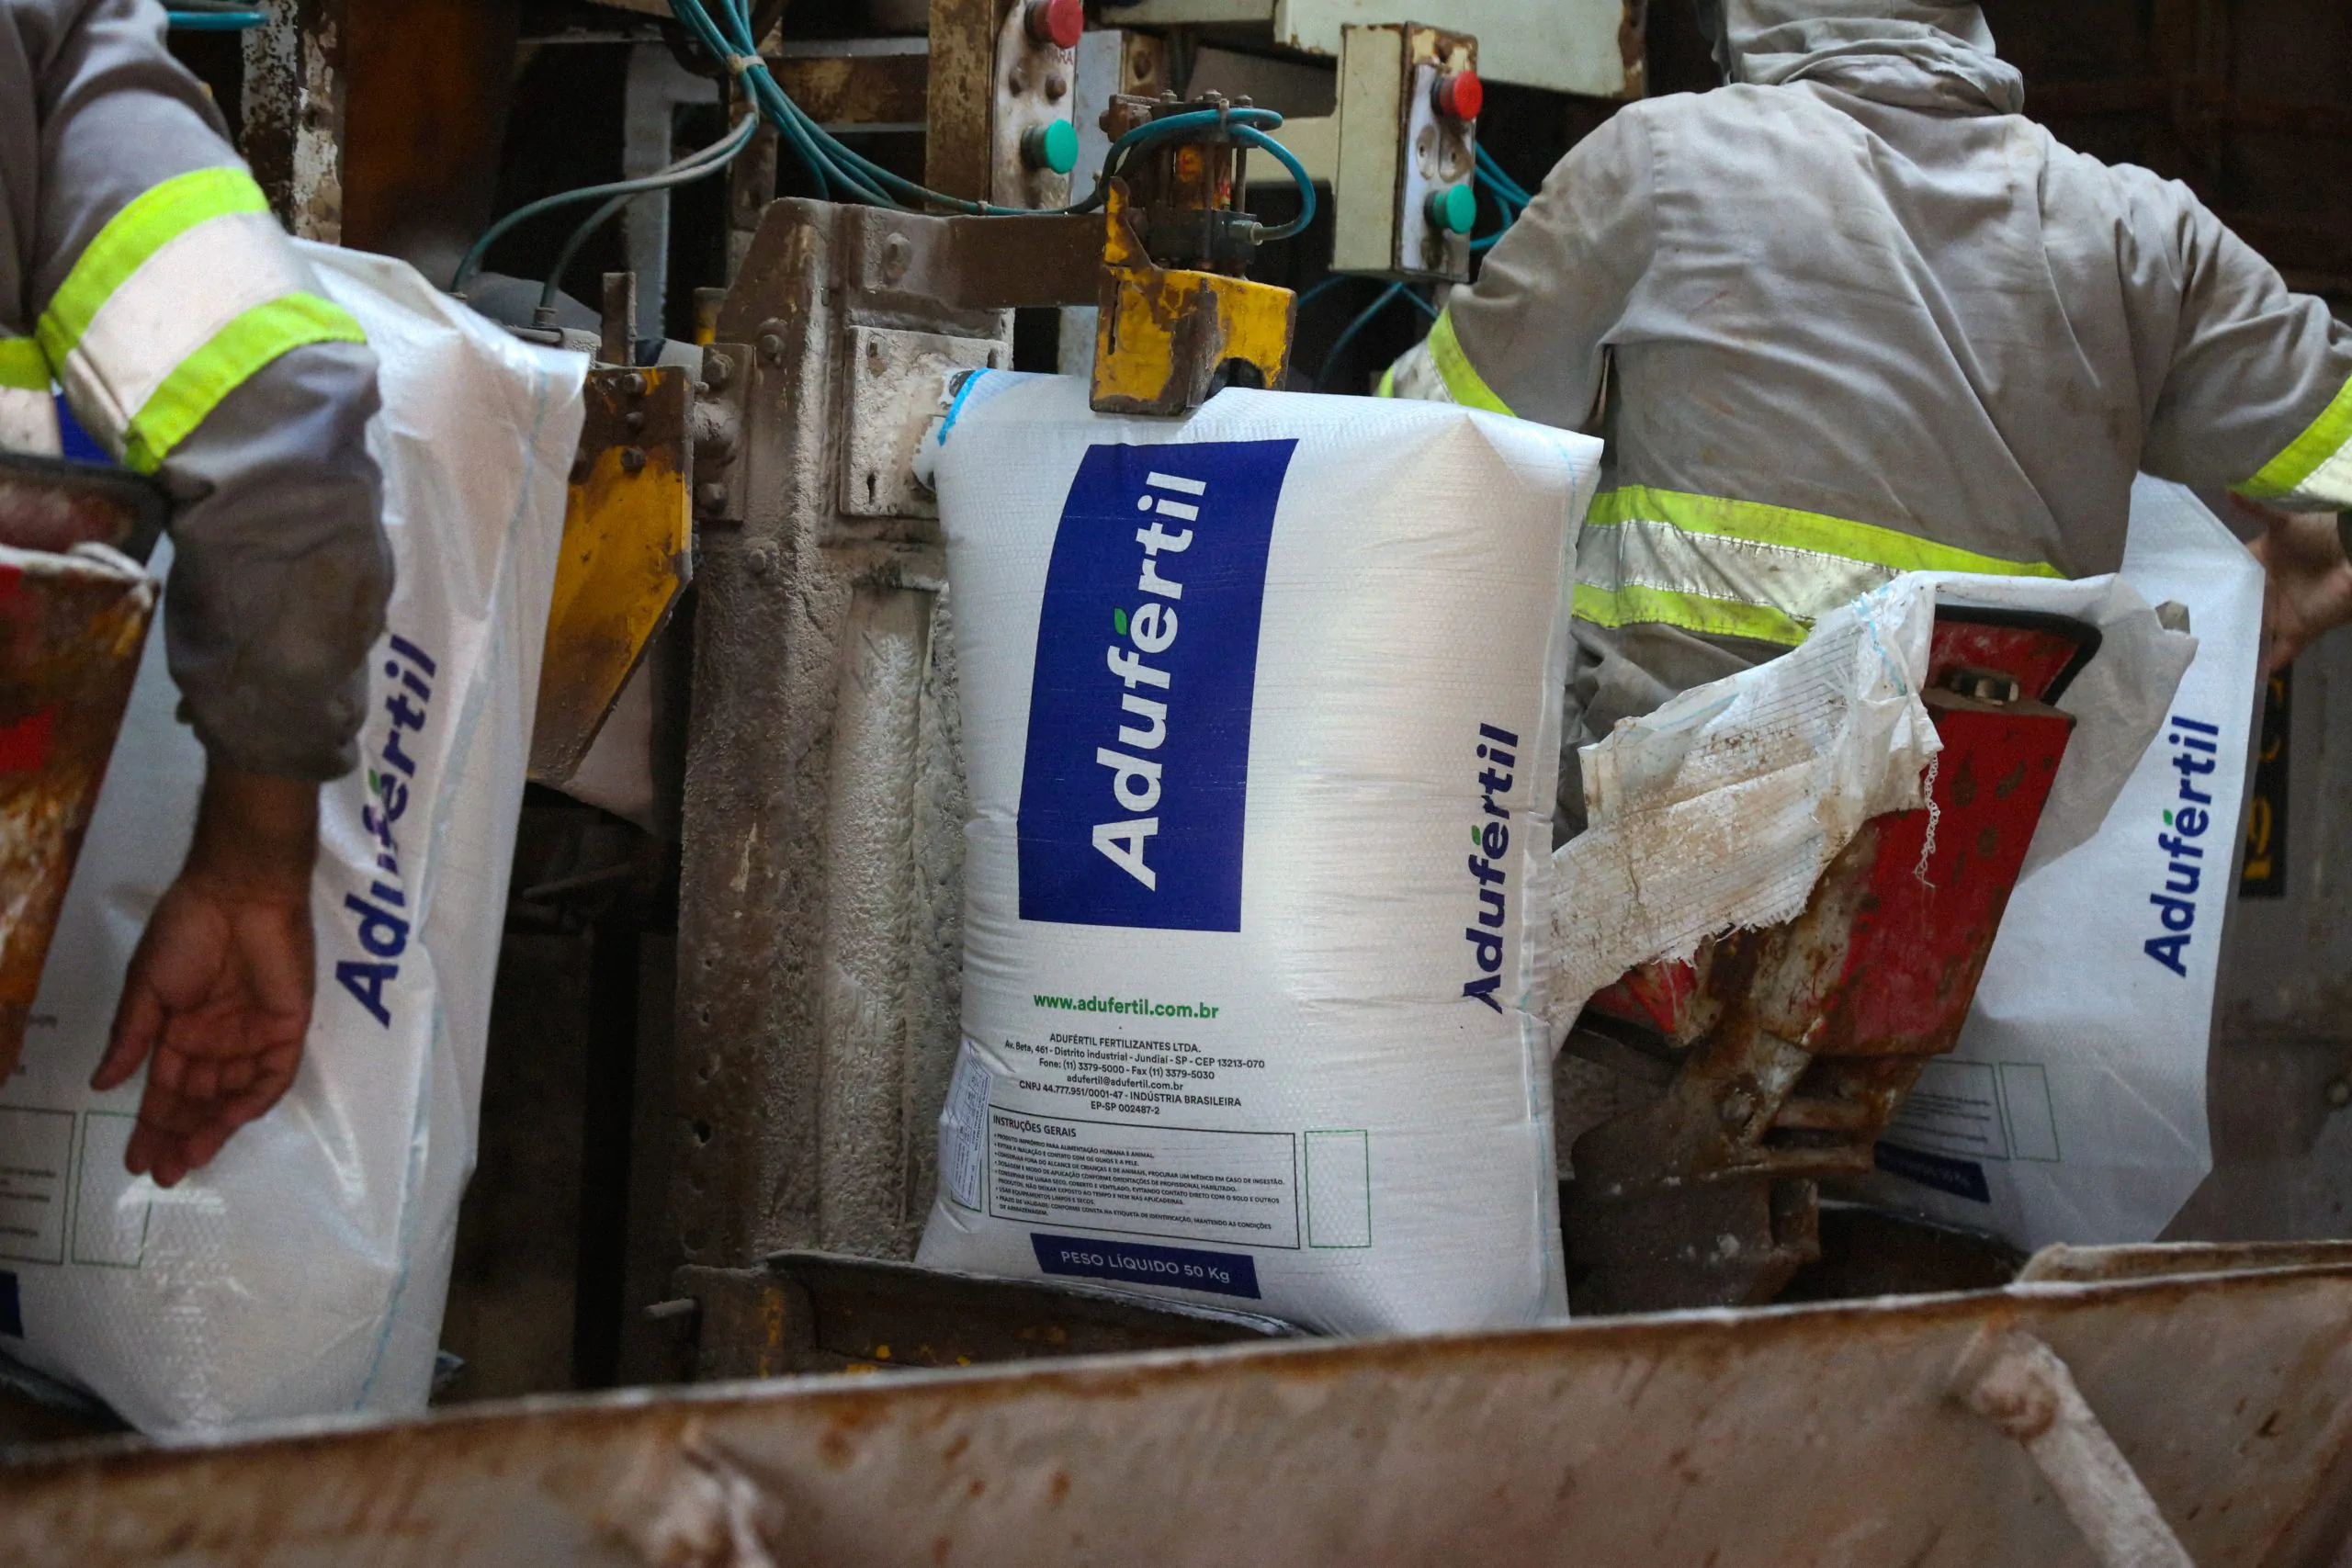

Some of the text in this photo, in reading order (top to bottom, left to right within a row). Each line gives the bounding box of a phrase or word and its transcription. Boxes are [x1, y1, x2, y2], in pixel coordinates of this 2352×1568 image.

[1091, 471, 1207, 892] Adufértil
[2143, 716, 2219, 978] Adufértil
[1462, 722, 1519, 1013] Adufértil
[1034, 995, 1219, 1019] www.adufertil.com.br
[1050, 1032, 1201, 1053] ADUFÉRTIL FERTILIZANTES LTDA.
[1016, 1042, 1034, 1054] Beta,
[1035, 1044, 1048, 1055] 461
[1055, 1046, 1085, 1058] Distrito
[1176, 1055, 1188, 1066] SP
[1195, 1056, 1215, 1066] CEP
[1217, 1058, 1265, 1069] 13213-070
[1039, 1058, 1061, 1068] Fone:
[1063, 1059, 1076, 1071] (11)
[1079, 1062, 1125, 1074] 3379-5000
[1132, 1066, 1147, 1076] Fax
[1149, 1066, 1163, 1078] (11)
[1165, 1069, 1215, 1080] 3379-5030
[1019, 1080, 1041, 1091] CNPJ
[1043, 1083, 1123, 1100] 44.777.951/0001-47
[1130, 1089, 1182, 1103] INDÚSTRIA
[1184, 1095, 1242, 1106] BRASILEIRA
[1067, 1074, 1183, 1090] adufertil@adufertil.com.br
[1091, 1101, 1160, 1115] EP-SP 002487-2
[993, 1114, 1077, 1138] INSTRUÇÕES GERAIS
[1060, 1250, 1230, 1283] PESO LÍQUIDO 50 Kg
